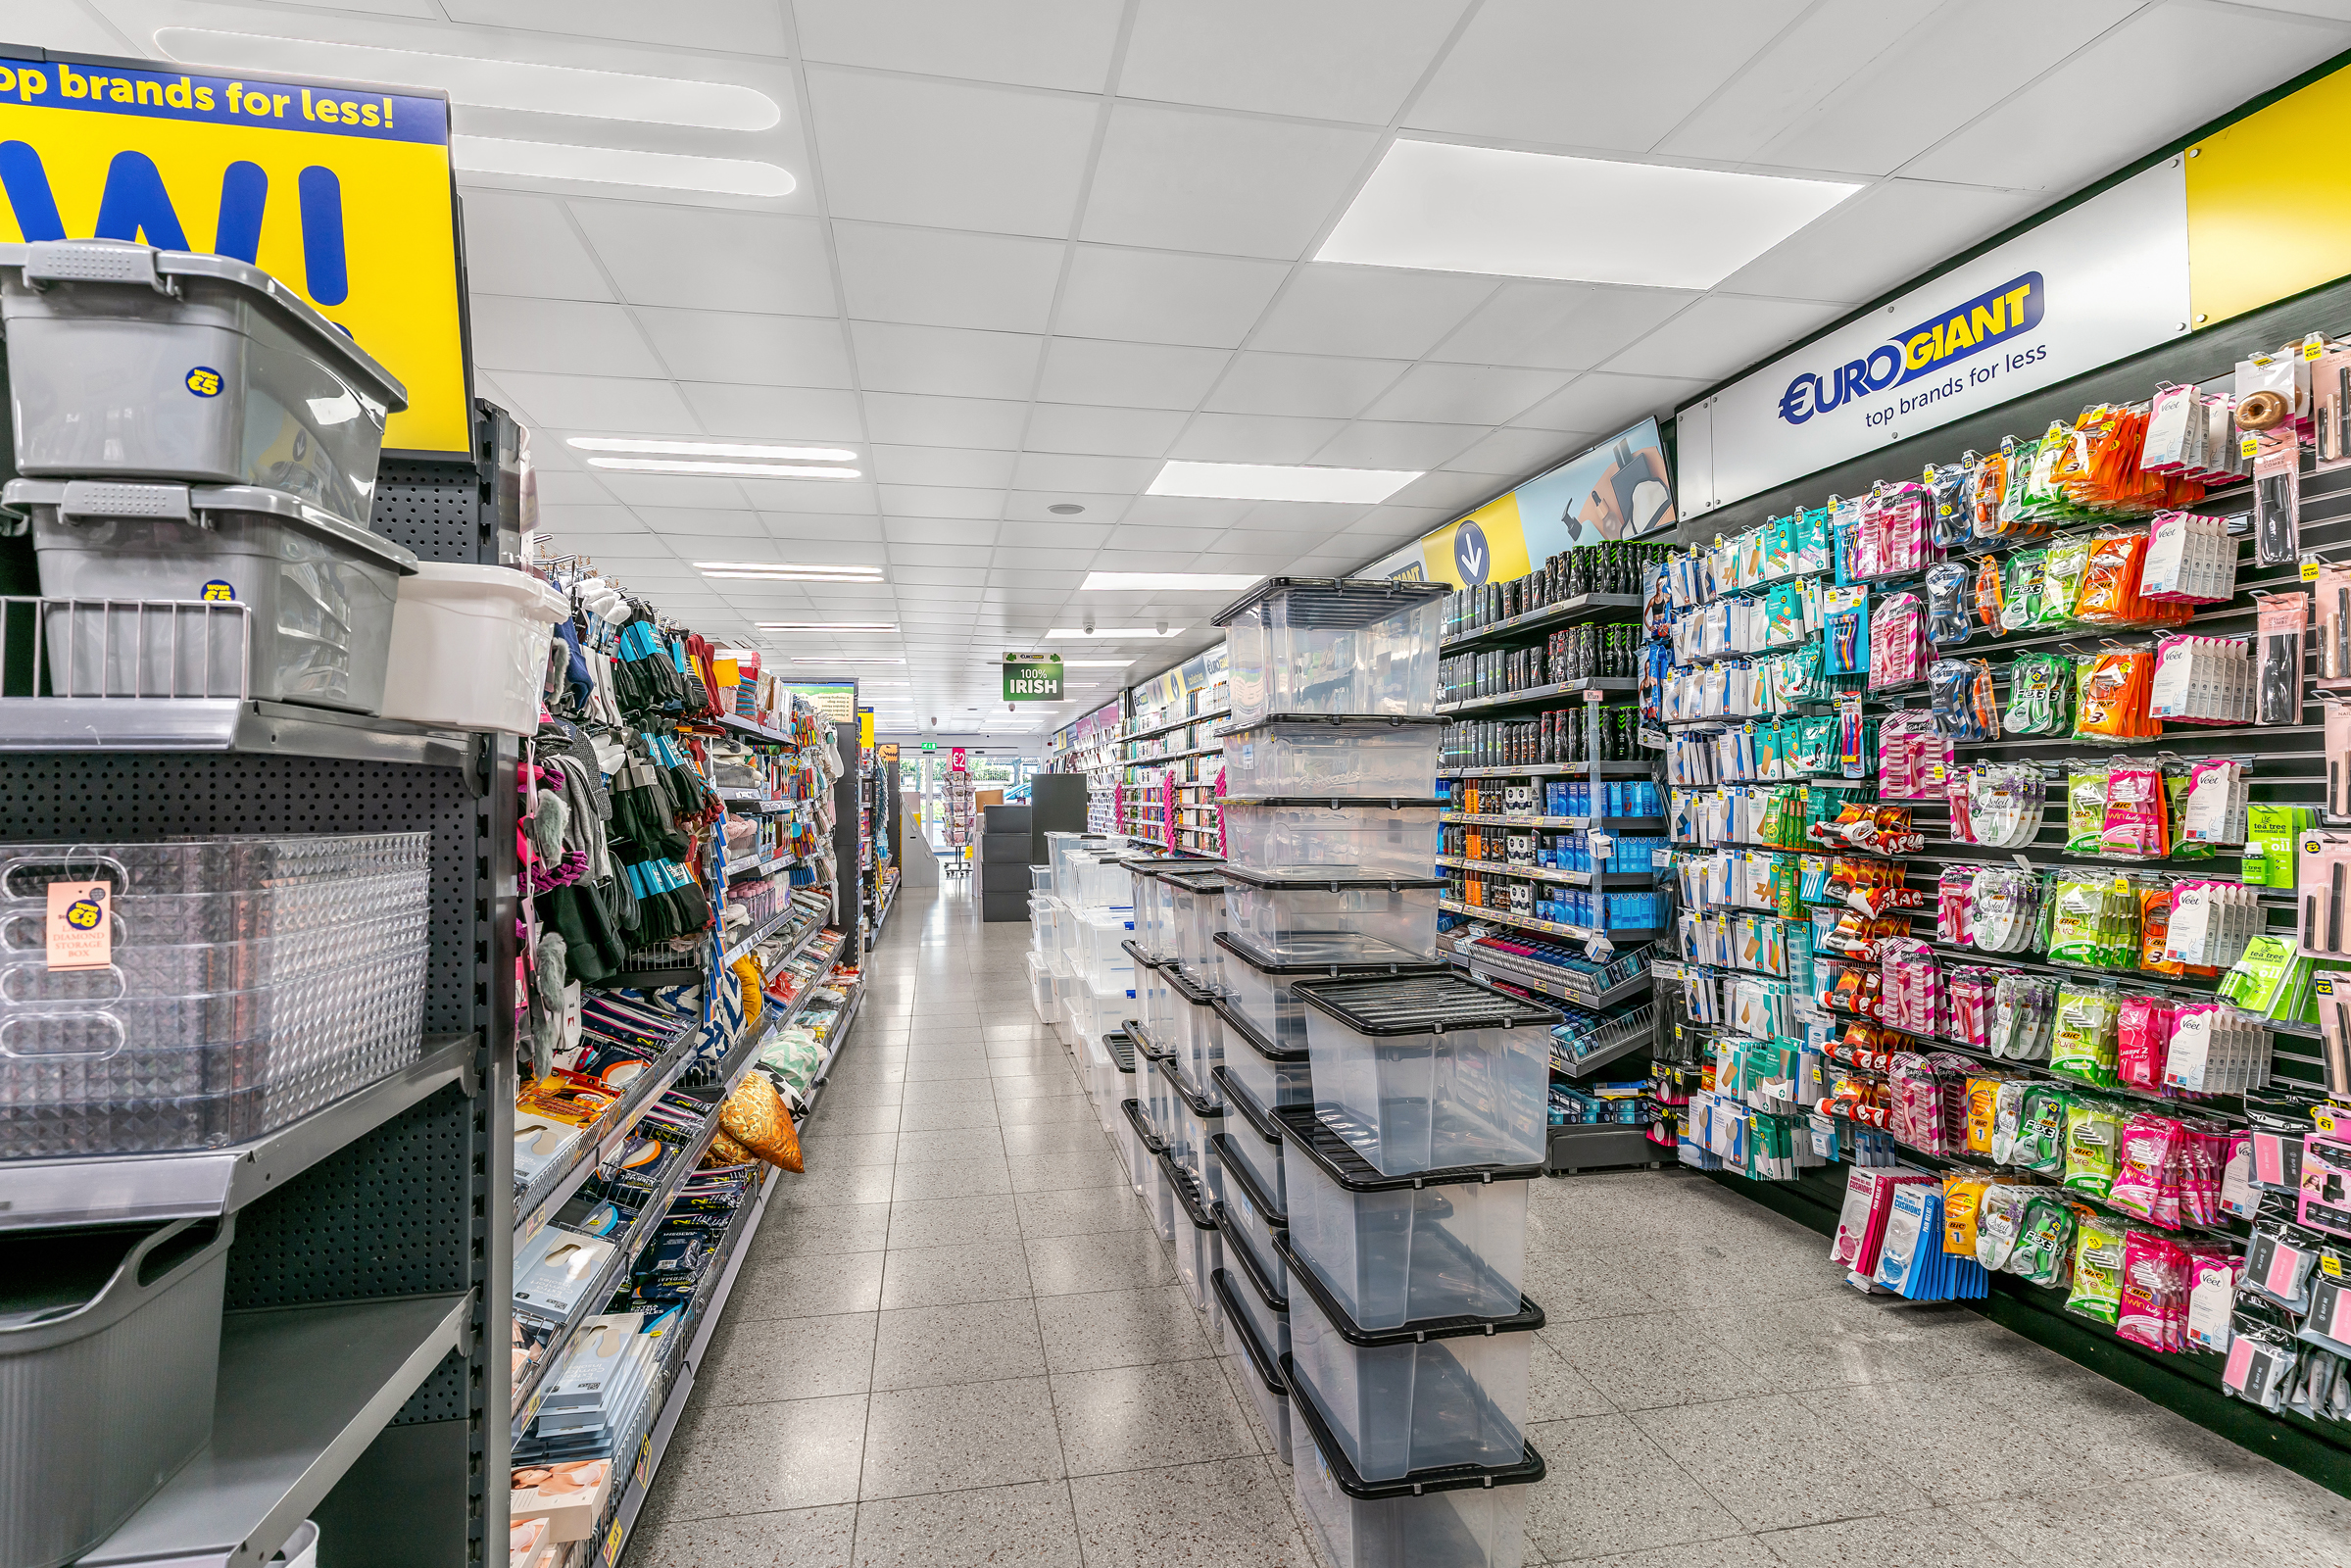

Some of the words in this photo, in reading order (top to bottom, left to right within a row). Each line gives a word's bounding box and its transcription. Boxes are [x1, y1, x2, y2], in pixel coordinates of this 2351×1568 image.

[59, 65, 214, 113] brands
[226, 81, 290, 118] for
[302, 87, 394, 128] less!
[188, 375, 219, 395] €5
[1865, 409, 1894, 428] top
[1899, 376, 1964, 416] brands
[1969, 361, 2000, 388] for
[2005, 344, 2047, 373] less
[2161, 400, 2180, 413] Veet
[2158, 527, 2177, 539] Veet
[2011, 585, 2042, 596] Flex3
[2165, 650, 2182, 662] Veet
[1021, 668, 1047, 678] 100%
[1010, 679, 1057, 694] IRISH
[953, 752, 965, 767] €2
[2199, 774, 2219, 785] Veet
[2108, 812, 2125, 821] win
[2271, 841, 2290, 852] oil
[2181, 895, 2200, 906] Veet
[69, 908, 97, 927] €8
[53, 932, 105, 941] DIAMOND
[2053, 925, 2075, 936] Pure
[55, 941, 103, 950] STORAGE
[2259, 965, 2280, 979] oil
[2318, 984, 2332, 994] €2
[2182, 1020, 2201, 1031] Veet
[2054, 1038, 2076, 1050] Pure
[2025, 1119, 2056, 1139] Flex3
[2320, 1120, 2331, 1129] €1
[2075, 1148, 2094, 1156] BIC
[2067, 1153, 2089, 1167] Pure
[2090, 1161, 2106, 1172] lady
[2131, 1159, 2146, 1168] BIC
[2139, 1173, 2156, 1186] lady
[1849, 1180, 1873, 1195] CUSHIONS
[1894, 1200, 1922, 1216] CUSHIONS
[1954, 1232, 1959, 1242] 1
[2025, 1231, 2055, 1251] Flex3
[2041, 1232, 2056, 1241] BIC
[2084, 1269, 2105, 1278] BIC
[530, 1279, 573, 1294] Comfort
[539, 1277, 571, 1289] Insoles
[2076, 1276, 2098, 1290] Pure
[2202, 1273, 2222, 1288] Veet
[536, 1285, 562, 1298] Extra
[2133, 1289, 2151, 1299] BIC
[2124, 1295, 2144, 1309] Twin
